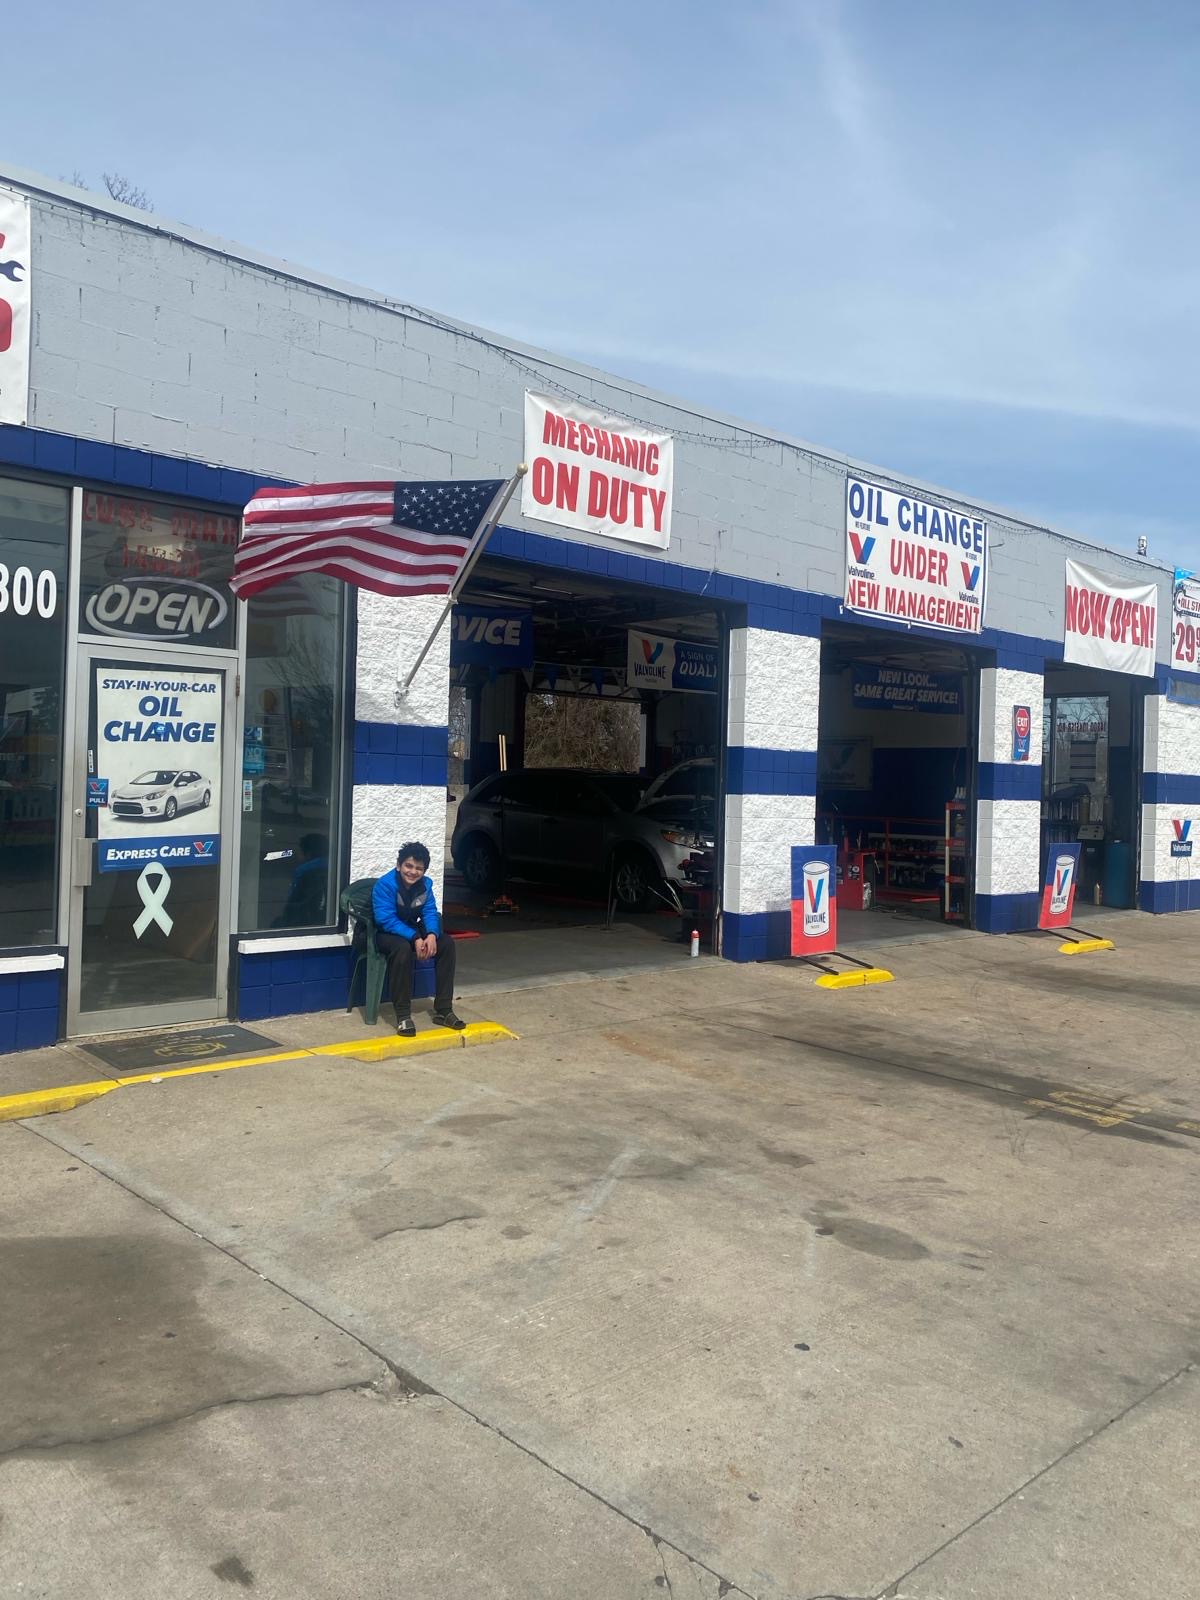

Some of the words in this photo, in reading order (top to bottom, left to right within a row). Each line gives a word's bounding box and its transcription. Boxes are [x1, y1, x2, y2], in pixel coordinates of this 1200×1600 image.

[543, 410, 659, 476] MECHANIC
[532, 457, 580, 512] ON
[587, 470, 667, 533] DUTY
[849, 483, 889, 526] OIL
[897, 498, 983, 554] CHANGE
[848, 565, 876, 580] Valvoline
[890, 538, 949, 587] UNDER
[96, 584, 214, 633] OPEN
[847, 579, 881, 611] NEW
[884, 586, 980, 632] MANAGEMENT
[1066, 585, 1111, 639] NOW
[1110, 597, 1155, 649] OPEN!
[633, 662, 667, 680] VALVOLINE
[878, 670, 902, 684] NEW
[102, 679, 216, 693] STAY-IN-YOUR-CAR
[854, 683, 883, 699] SAME
[884, 686, 916, 701] GREAT
[917, 689, 959, 705] SERVICE!
[138, 696, 183, 717] OIL
[104, 721, 216, 743] CHANGE
[1017, 717, 1028, 727] EXIT
[106, 848, 158, 860] EXPRESS
[160, 846, 191, 858] CARE
